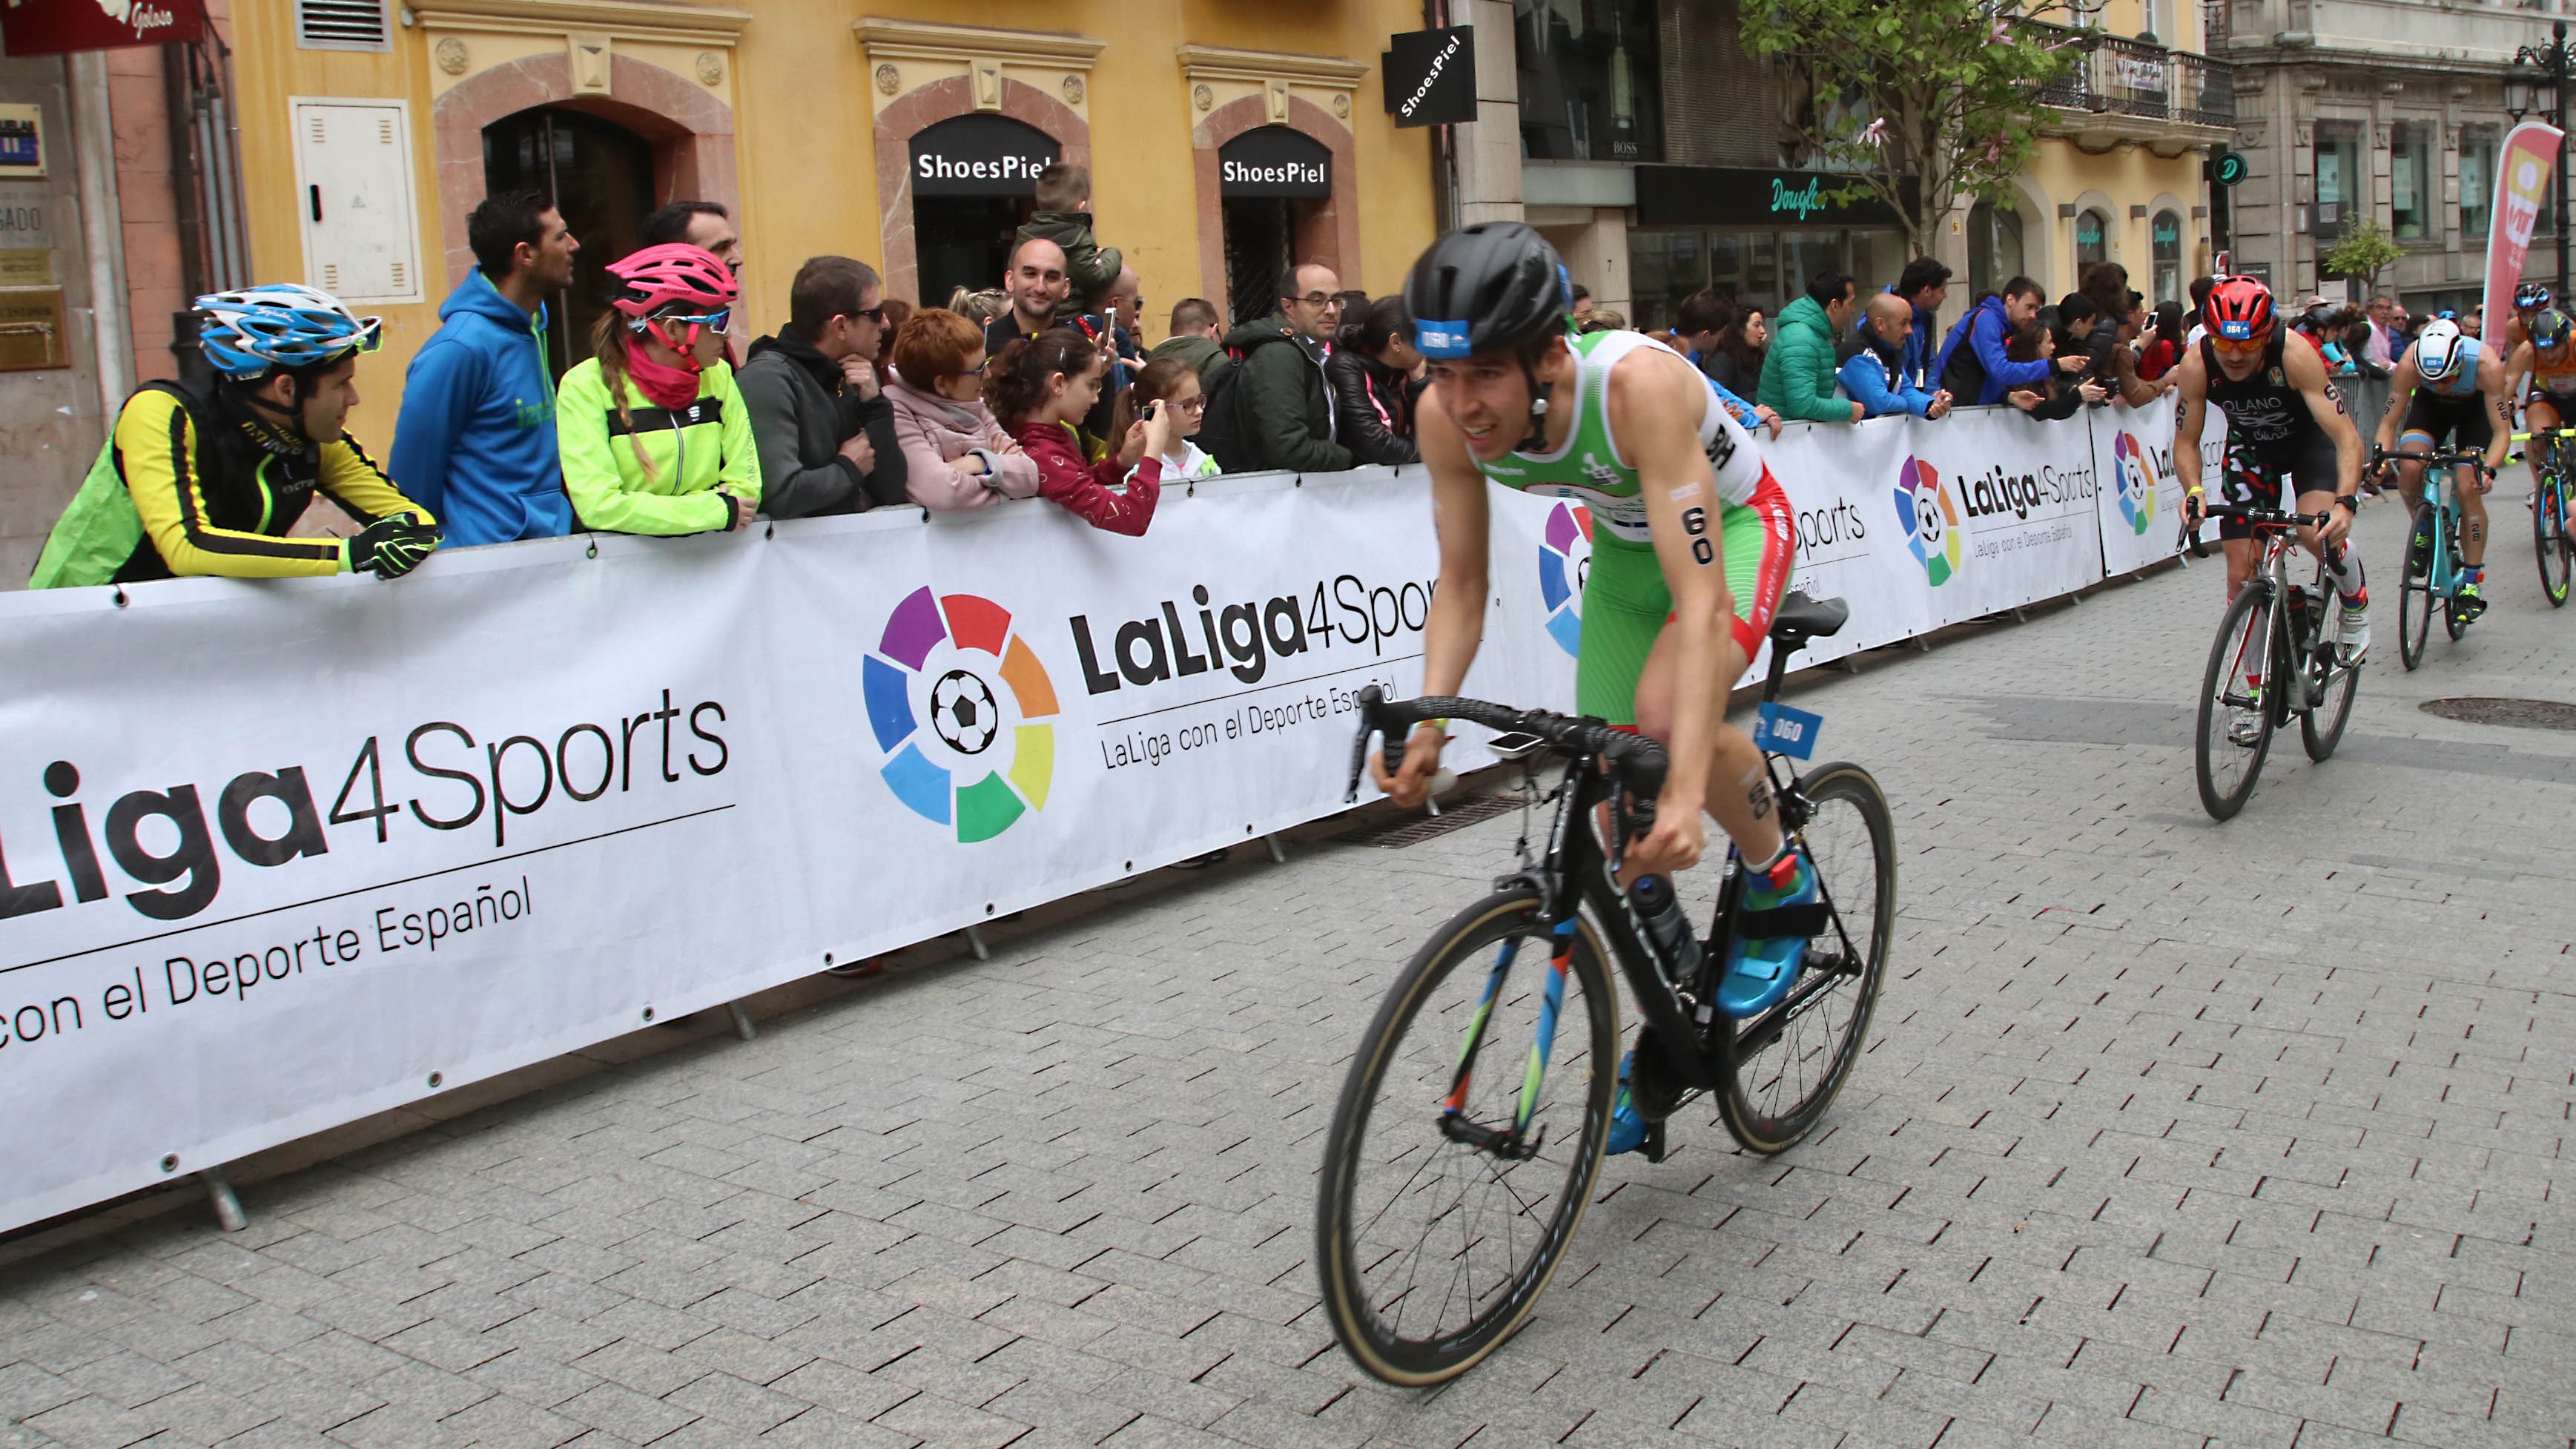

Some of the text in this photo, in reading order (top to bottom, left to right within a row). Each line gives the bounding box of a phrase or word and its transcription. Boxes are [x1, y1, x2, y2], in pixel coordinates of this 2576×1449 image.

[132, 2, 174, 39] Goloso
[1401, 35, 1460, 117] ShoesPiel
[1614, 141, 1638, 155] BOSS
[1223, 161, 1324, 183] ShoesPiel
[2227, 325, 2241, 334] 064
[2222, 397, 2282, 412] OLANO
[1958, 463, 2093, 520] LaLiga4Sports
[1682, 506, 1713, 566] 60
[1069, 575, 1439, 695] LaLiga4Spor
[1101, 673, 1398, 770] LaLiga con el Deporte Espol
[1772, 718, 1804, 742] 060
[104, 966, 148, 1020] el
[165, 925, 361, 1006] Deporte
[375, 874, 532, 953] Español
